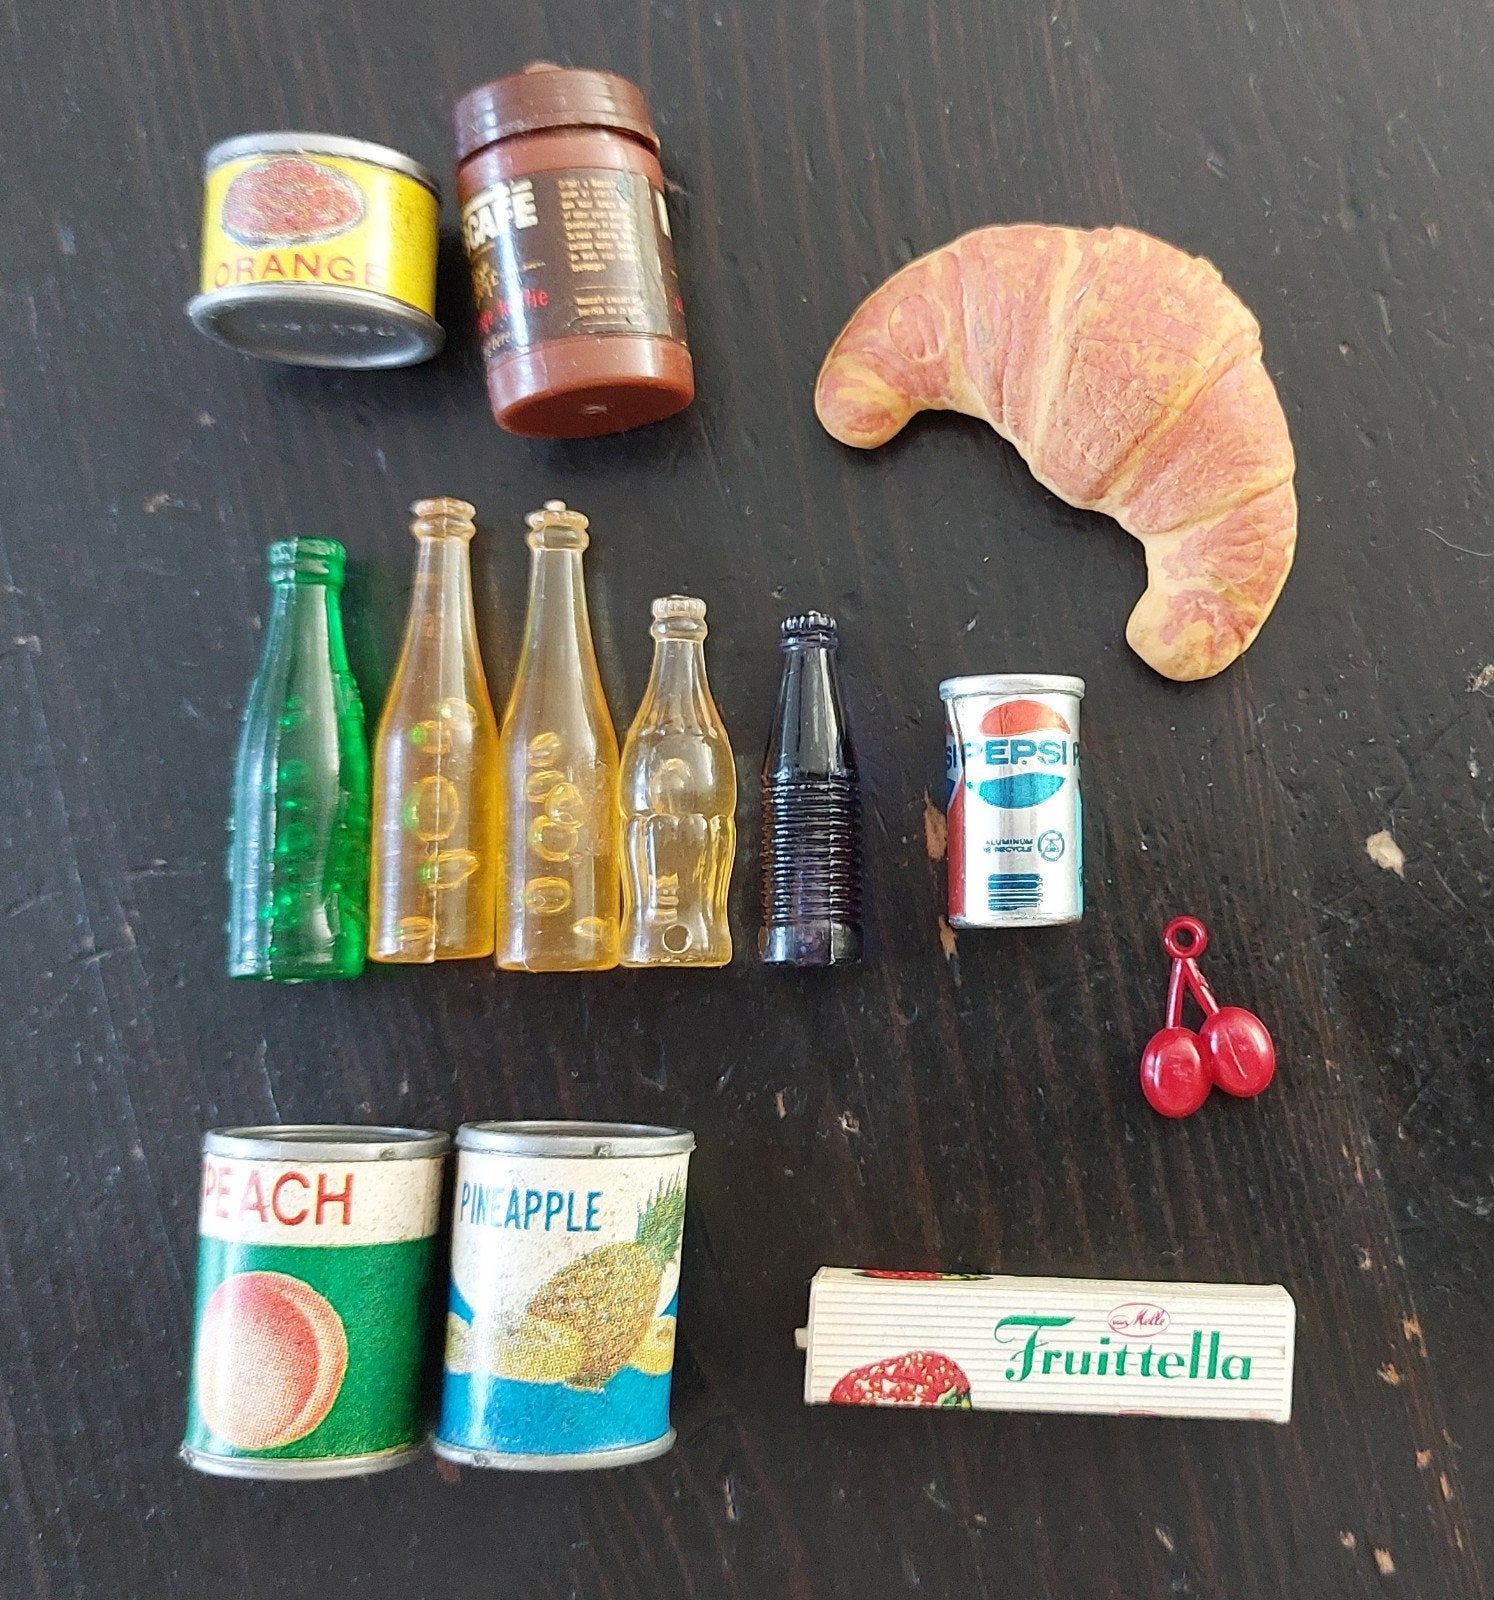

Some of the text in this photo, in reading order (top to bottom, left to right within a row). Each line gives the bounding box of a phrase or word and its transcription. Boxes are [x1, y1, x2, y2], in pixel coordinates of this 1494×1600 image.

[214, 253, 387, 289] ORANGE
[962, 739, 1067, 765] PEPSI
[985, 838, 1034, 846] ALUMINUM
[203, 1162, 355, 1227] PEACH
[460, 1180, 604, 1232] PINEAPPLE
[994, 1314, 1252, 1382] Fruittella
